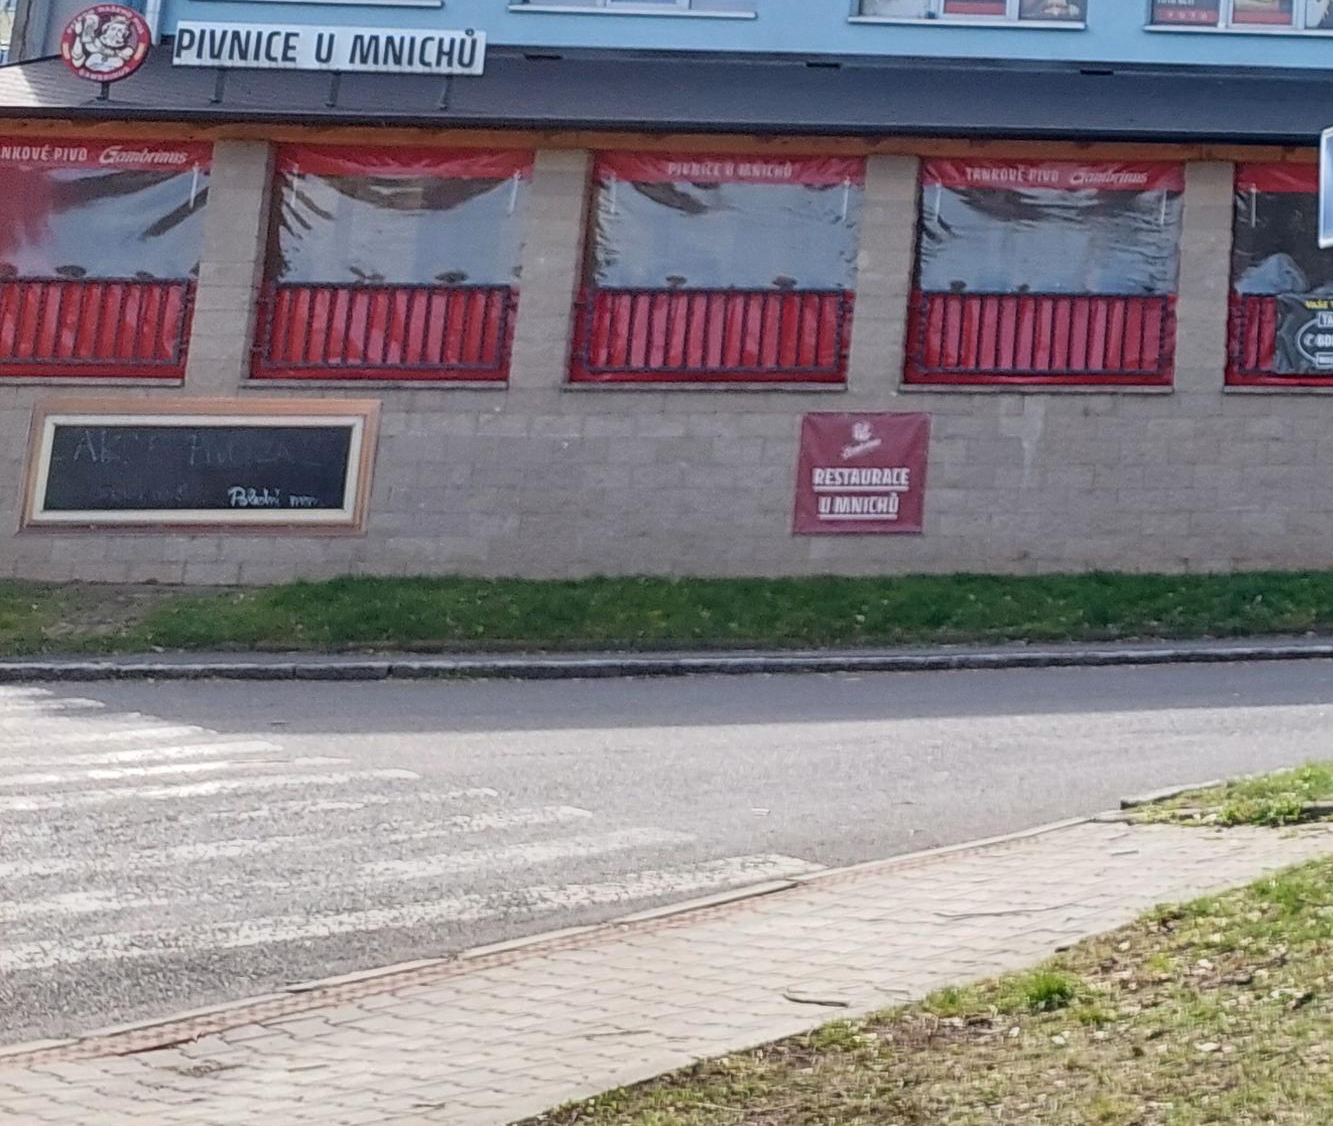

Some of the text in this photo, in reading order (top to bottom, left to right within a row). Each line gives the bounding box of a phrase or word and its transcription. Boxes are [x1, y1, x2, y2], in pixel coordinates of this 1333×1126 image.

[175, 28, 479, 68] PIVNICE U MNICHŮ
[54, 146, 88, 162] PIVO
[99, 145, 188, 164] Gambrinus
[667, 162, 720, 176] PIVNICE
[726, 163, 735, 176] U
[965, 164, 1148, 185] TANKOVÉ PIVO Gambrinus
[812, 467, 911, 485] RESTAURACE
[818, 491, 899, 514] U MNICHŮ
